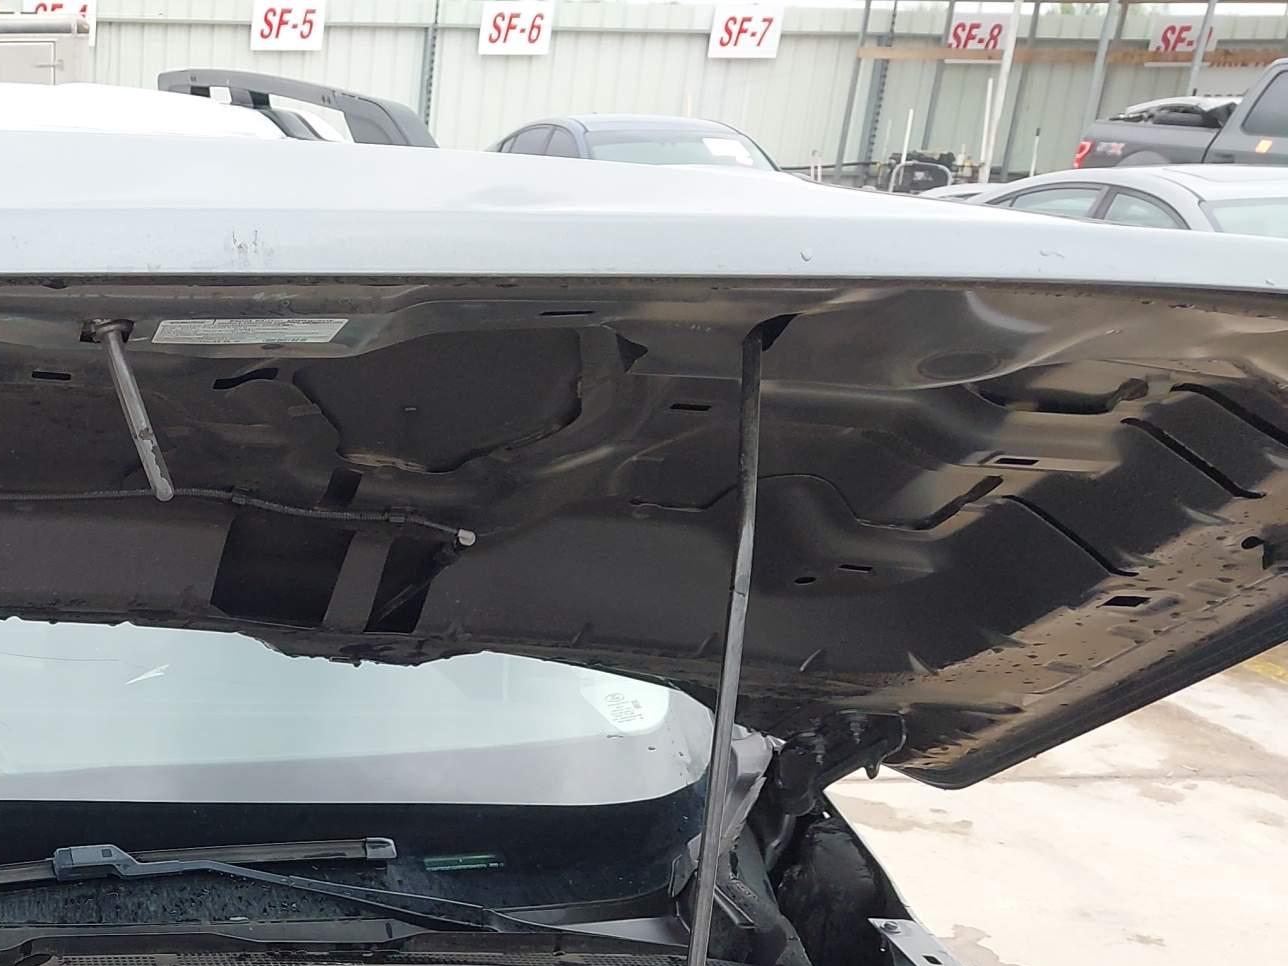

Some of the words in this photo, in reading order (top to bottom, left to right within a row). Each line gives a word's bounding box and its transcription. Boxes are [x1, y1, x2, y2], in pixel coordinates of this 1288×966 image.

[260, 8, 316, 39] SF-5
[488, 12, 544, 44] SF-6
[719, 16, 774, 48] SF-7
[948, 22, 1002, 48] SF-8
[1156, 25, 1213, 51] SF-
